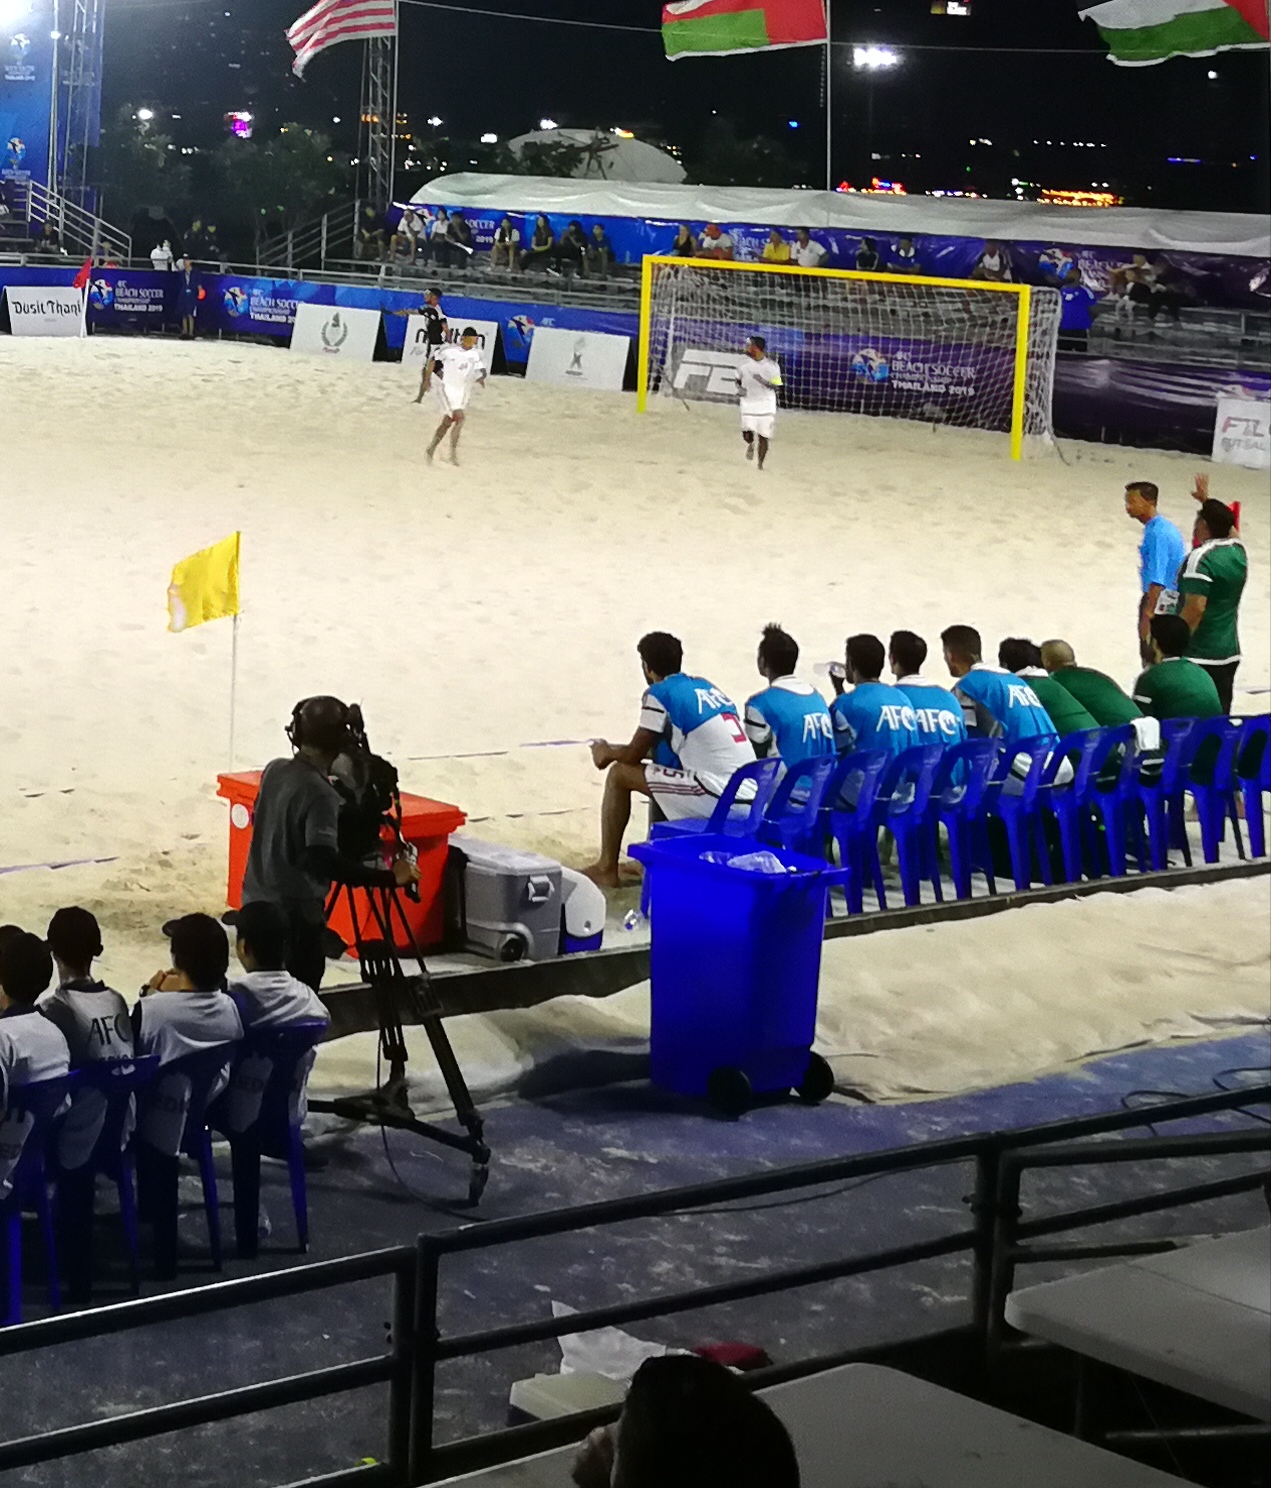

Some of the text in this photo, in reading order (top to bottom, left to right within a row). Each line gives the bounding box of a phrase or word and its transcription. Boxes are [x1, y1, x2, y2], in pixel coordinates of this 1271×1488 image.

[11, 300, 81, 317] Dusit Thani
[876, 705, 916, 732] AFC
[89, 1013, 133, 1047] AFC
